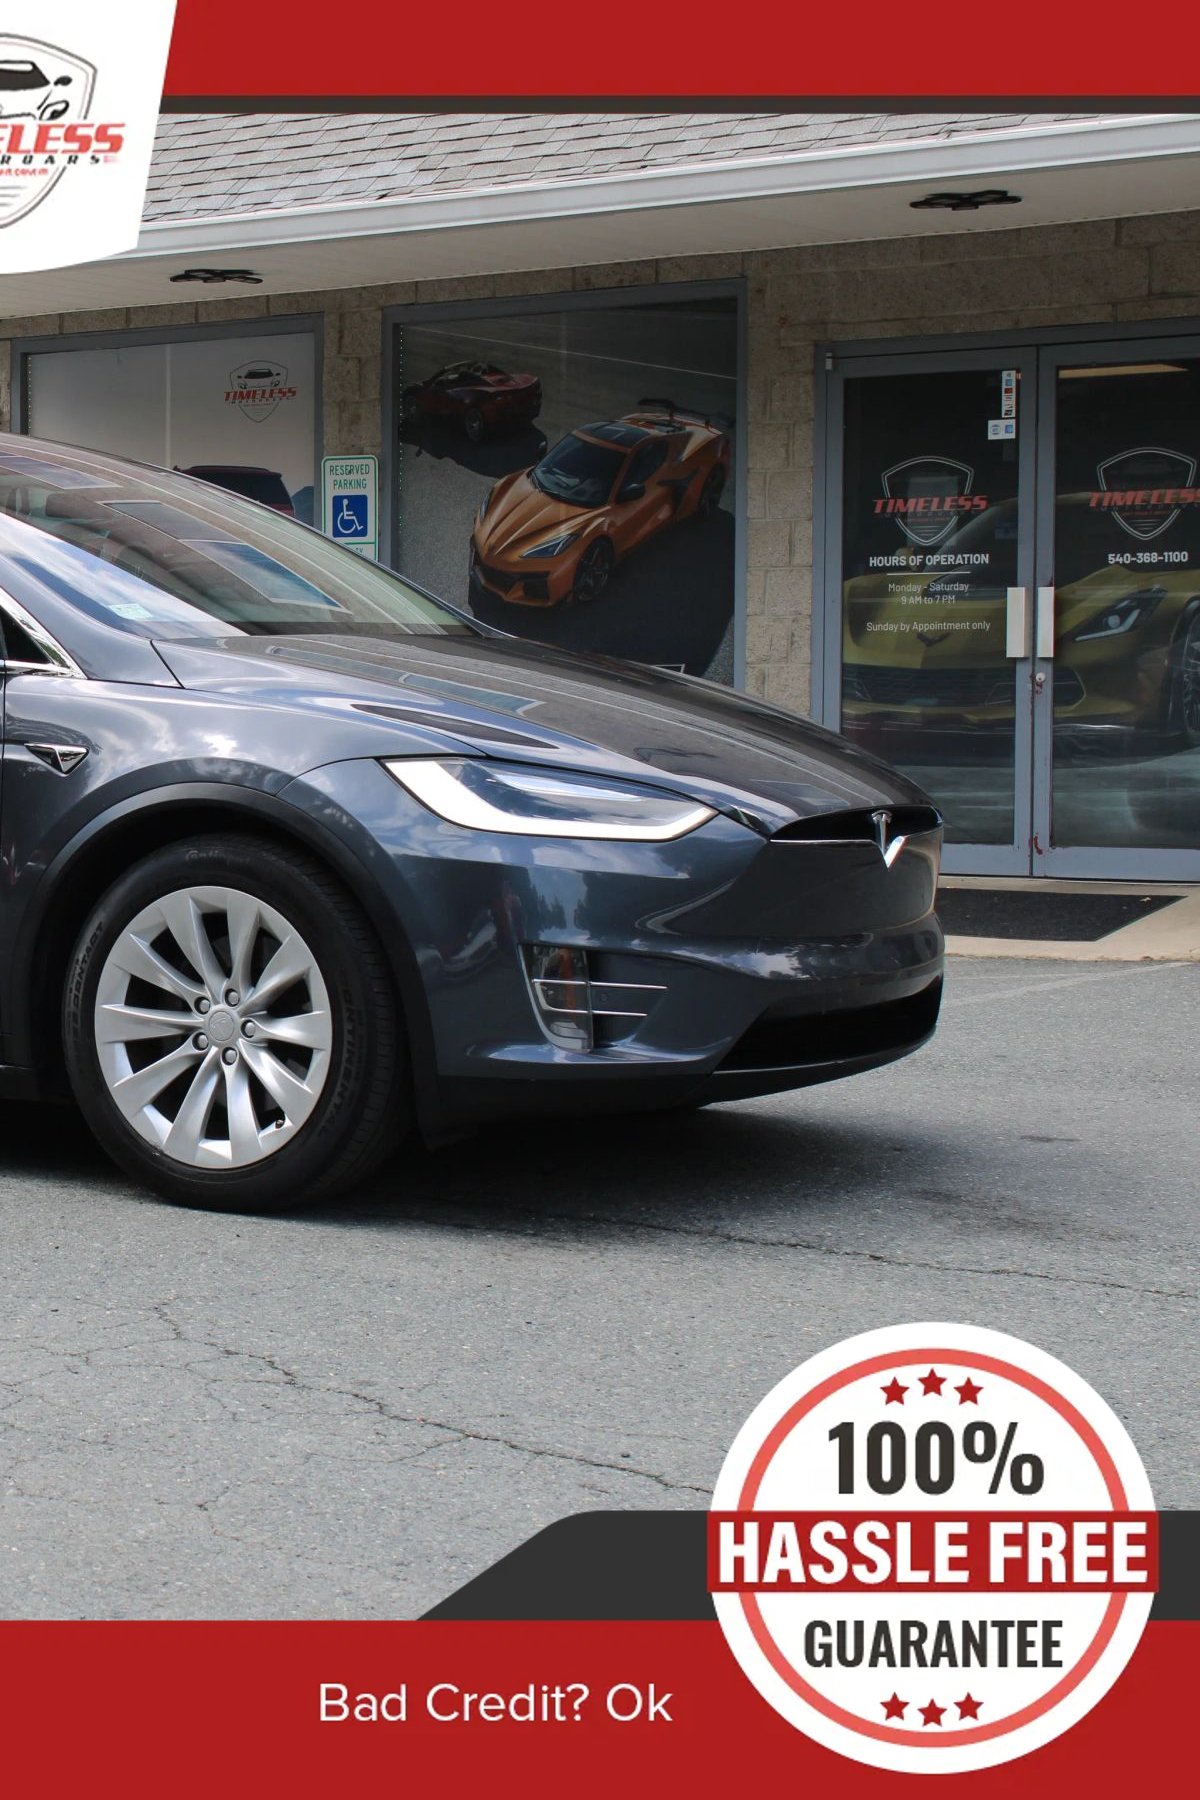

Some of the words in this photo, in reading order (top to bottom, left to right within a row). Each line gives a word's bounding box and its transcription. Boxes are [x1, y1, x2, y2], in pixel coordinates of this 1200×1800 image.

[224, 386, 297, 402] TIMELESS
[329, 463, 370, 476] RESERVED
[333, 478, 367, 491] PARKING
[873, 495, 989, 514] TIMELESS
[869, 556, 906, 567] HOURS
[908, 555, 923, 566] OF
[925, 553, 990, 565] OPERATION
[1108, 551, 1189, 564] 540-368-1100
[888, 583, 922, 594] Monday
[929, 582, 969, 593] Saturday
[908, 595, 922, 605] AM
[923, 595, 933, 605] to
[942, 594, 956, 604] PM
[866, 621, 898, 632] Sunday
[900, 621, 910, 632] by
[912, 619, 970, 632] Appointment
[971, 619, 991, 630] only
